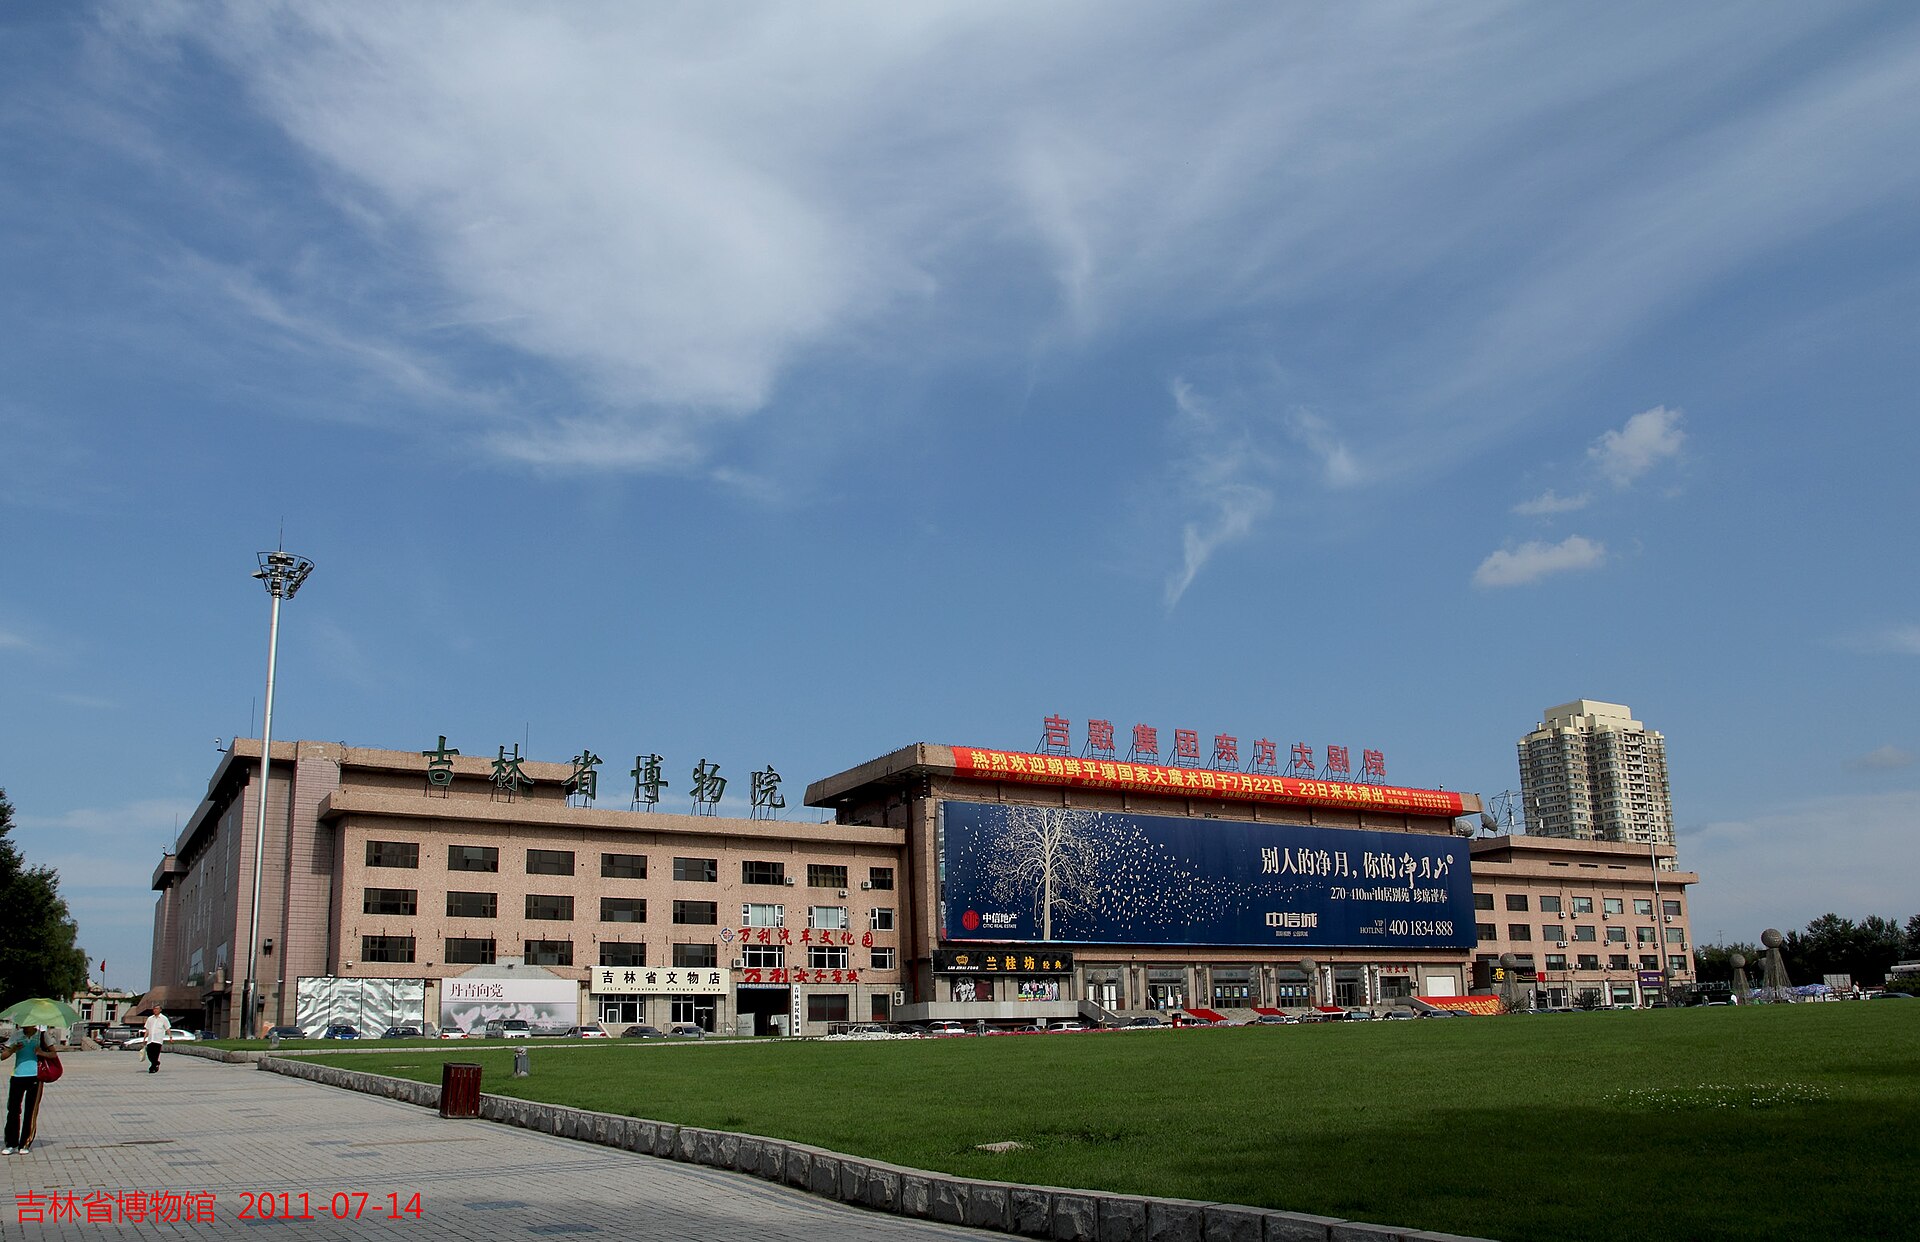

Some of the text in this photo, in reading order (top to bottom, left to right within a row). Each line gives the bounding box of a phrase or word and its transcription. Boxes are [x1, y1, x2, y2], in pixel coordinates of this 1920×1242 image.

[1044, 714, 1387, 776] 吉歌集团东方大剧院
[422, 735, 786, 809] 吉林省博物院
[971, 751, 1385, 803] 热烈欢迎朝鲜平壤国家大魔术团于7月22日、23日来长演出
[982, 912, 1018, 924] 中信地产
[1265, 912, 1318, 928] 中信城
[1374, 919, 1384, 927] VIP
[1359, 927, 1384, 935] HOTLINE
[1388, 919, 1454, 936] 400 1834 888
[737, 928, 874, 948] 万利汽车文化园
[986, 955, 1063, 971] 兰桂坊 经典
[602, 970, 721, 985] 吉林省文物店
[743, 968, 860, 984] 万利女子驾校
[450, 983, 503, 998] 丹青向党
